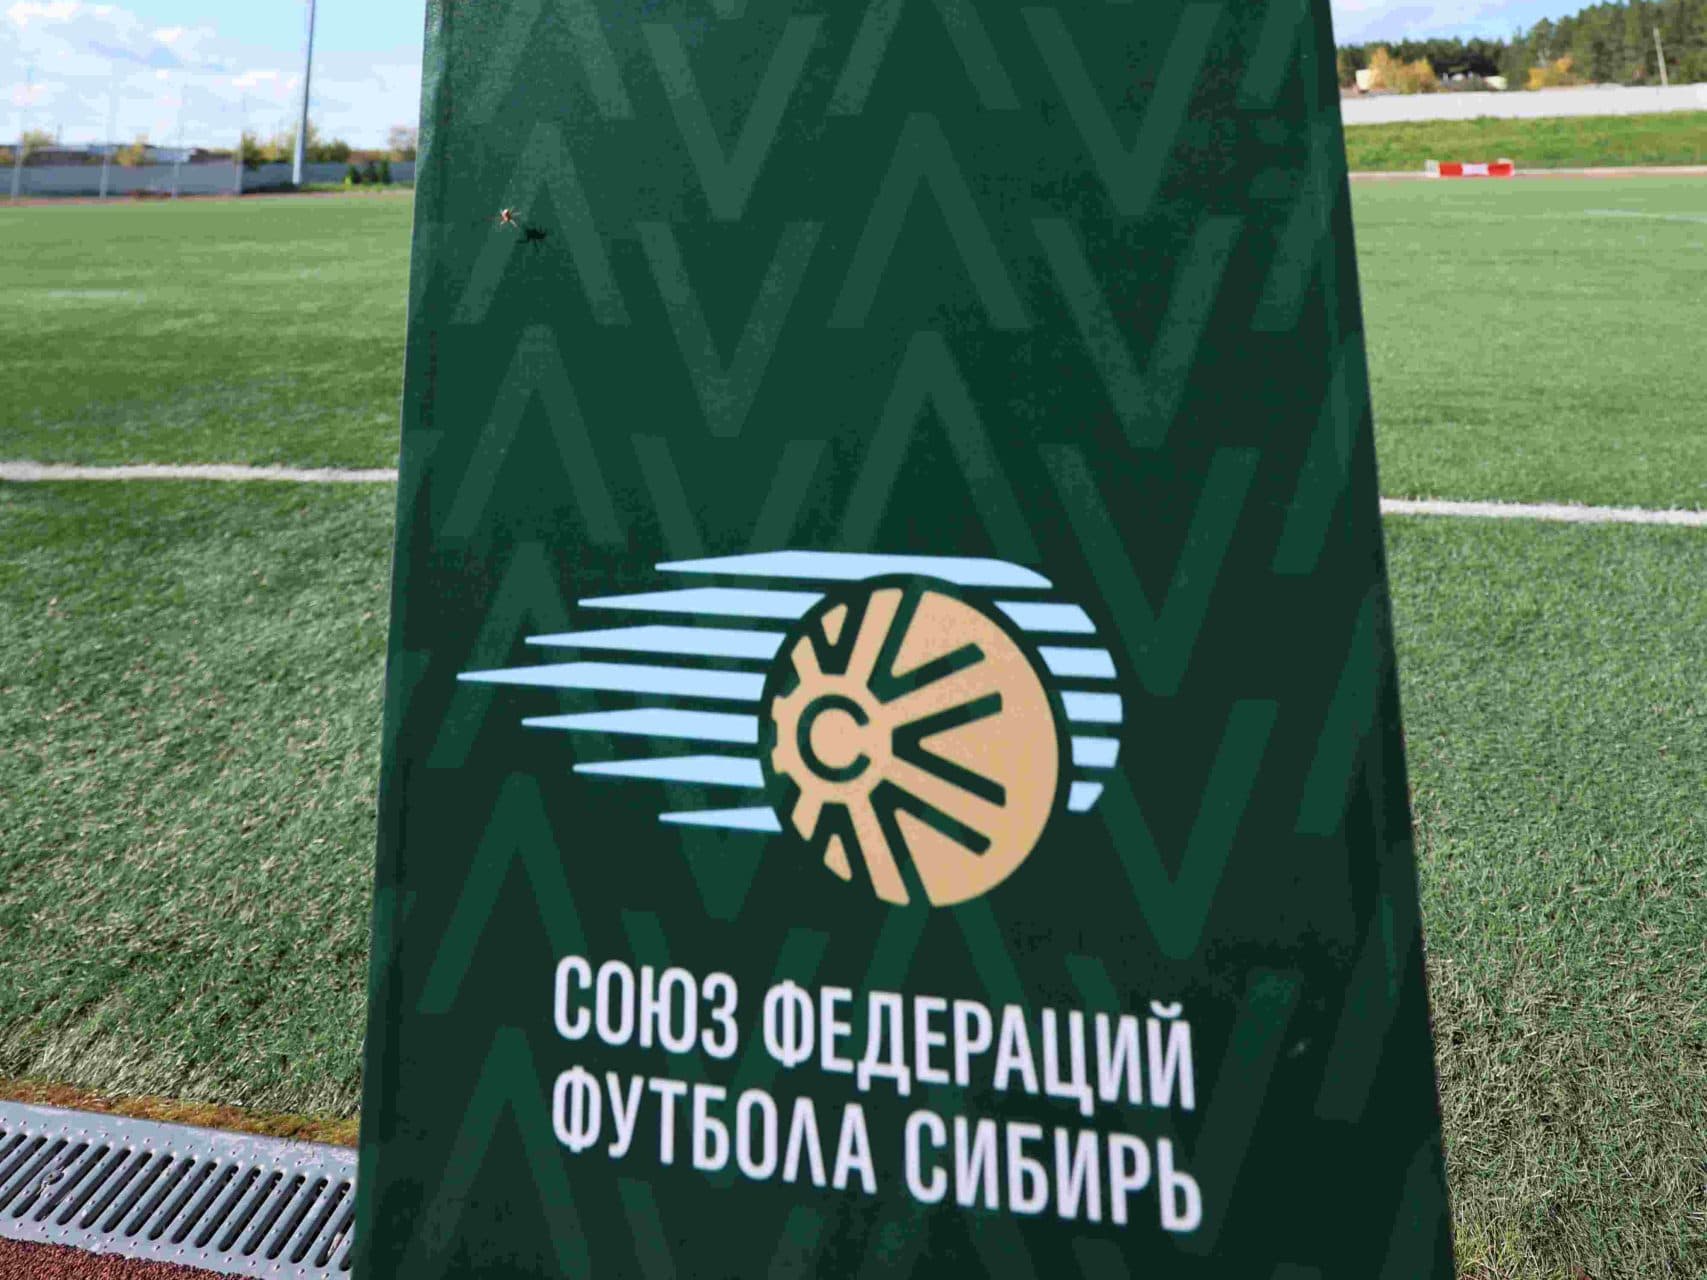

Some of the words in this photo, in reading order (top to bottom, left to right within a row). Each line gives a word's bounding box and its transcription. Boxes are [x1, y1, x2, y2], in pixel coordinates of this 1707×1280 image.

[552, 954, 738, 1058] СОЮЗ
[762, 979, 1196, 1116] ФЕДЕРАЦИЙ
[551, 1065, 877, 1194] ФУТБОЛА
[904, 1109, 1203, 1232] СИБИРЬ
